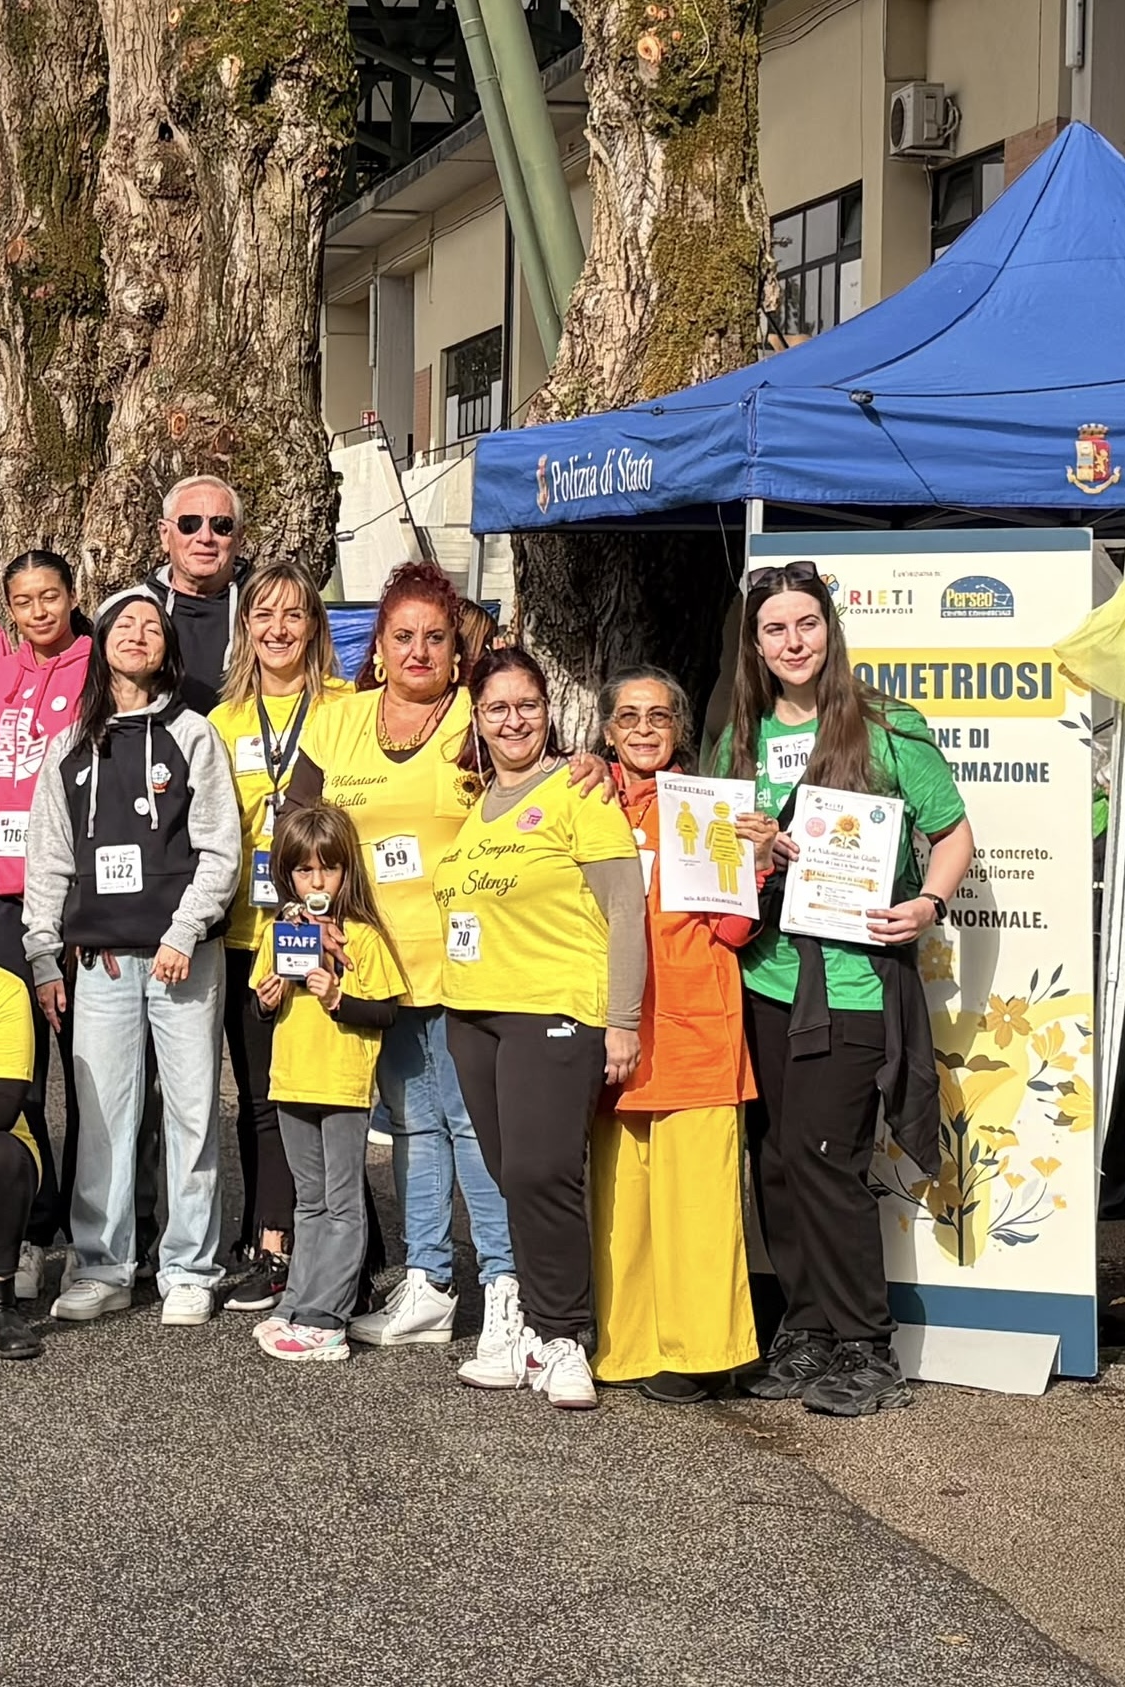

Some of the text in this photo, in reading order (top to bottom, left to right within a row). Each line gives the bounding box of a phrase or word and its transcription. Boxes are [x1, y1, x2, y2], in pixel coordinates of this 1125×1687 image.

[551, 447, 653, 503] Polizia di Stato
[849, 590, 913, 606] RIETI
[946, 588, 993, 608] Perseo
[969, 728, 989, 748] DI
[777, 752, 808, 769] 1070
[385, 850, 408, 867] 69
[990, 848, 1053, 860] concreto.
[105, 864, 133, 879] 1122
[950, 909, 1048, 929] NORMALE.
[278, 936, 317, 948] STAFF
[456, 931, 471, 947] 70
